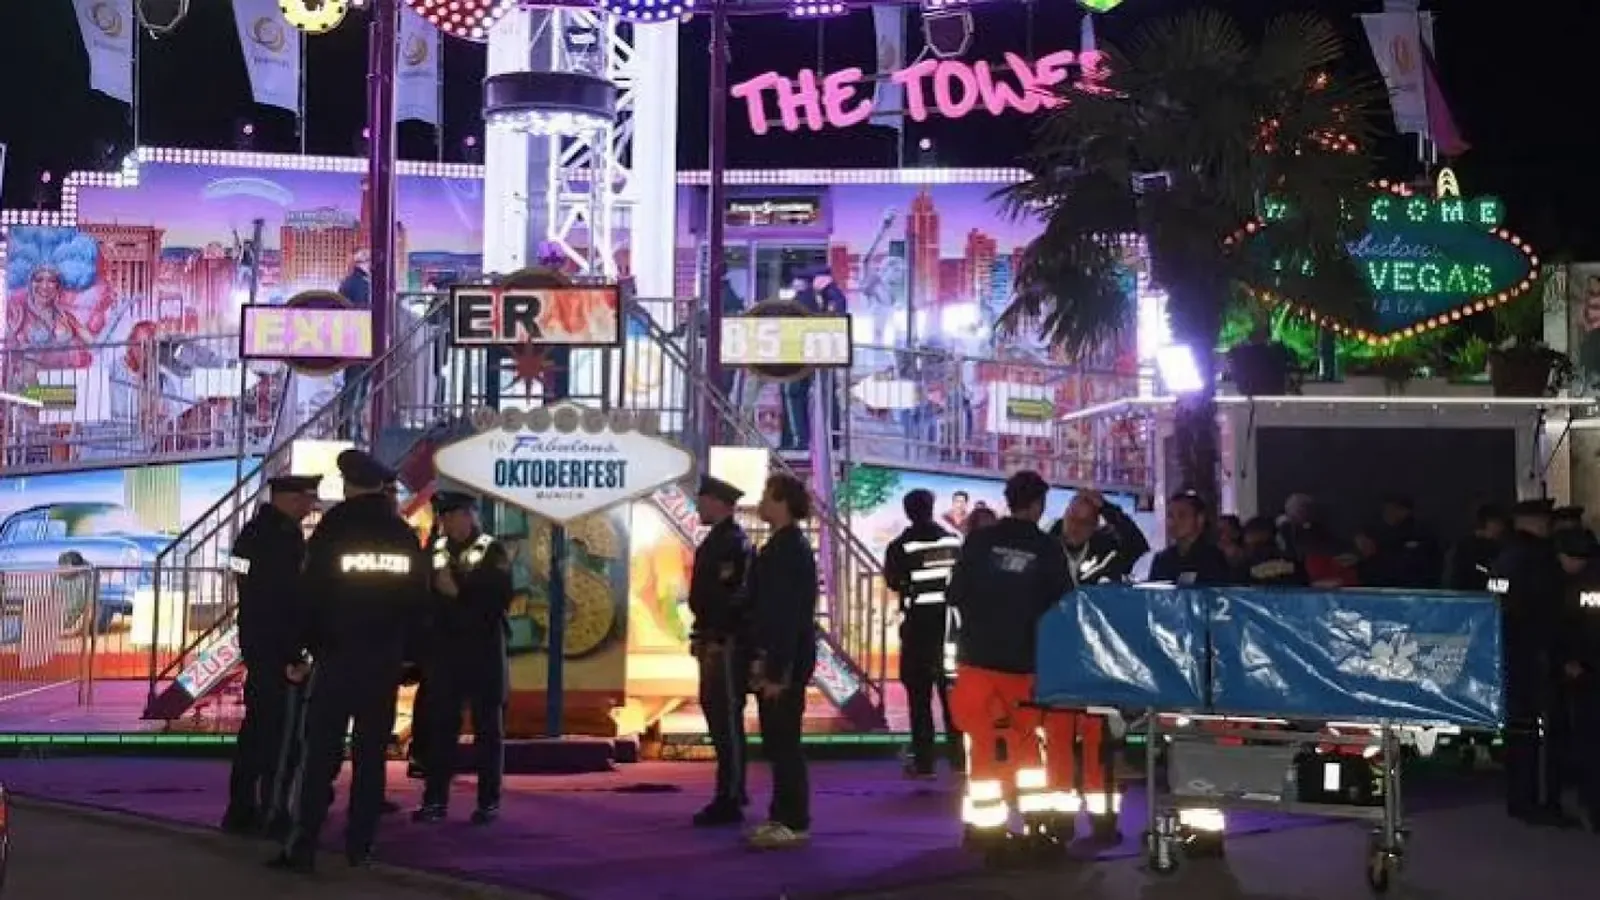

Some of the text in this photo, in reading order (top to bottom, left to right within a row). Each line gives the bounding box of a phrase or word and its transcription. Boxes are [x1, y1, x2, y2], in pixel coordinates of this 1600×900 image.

[731, 68, 873, 135] THE
[1264, 199, 1498, 223] WCOME
[1368, 260, 1493, 294] VEGAS
[457, 294, 543, 340] ER
[493, 458, 628, 489] OKTOBERFEST
[341, 554, 411, 574] POLIZEI
